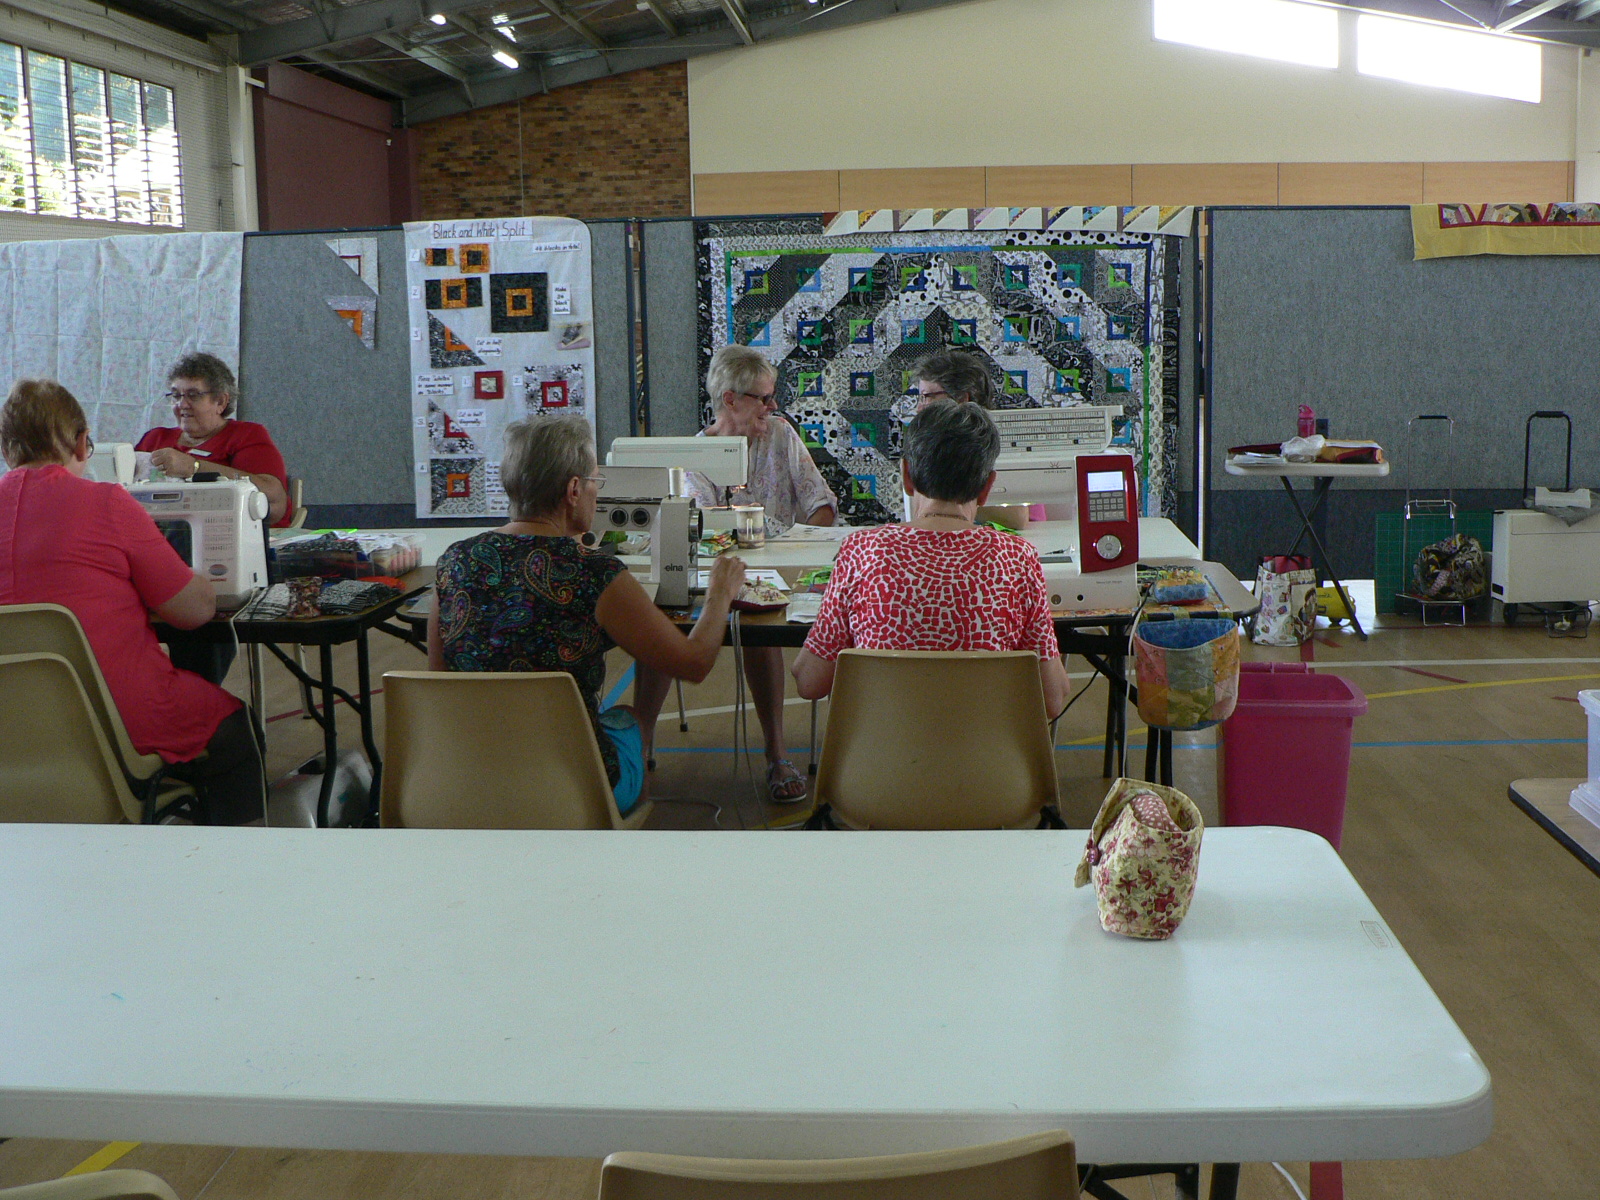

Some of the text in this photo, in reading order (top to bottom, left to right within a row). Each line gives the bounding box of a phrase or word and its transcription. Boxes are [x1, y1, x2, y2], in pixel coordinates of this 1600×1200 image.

[433, 220, 526, 240] Black and White Split
[664, 563, 684, 571] elna
